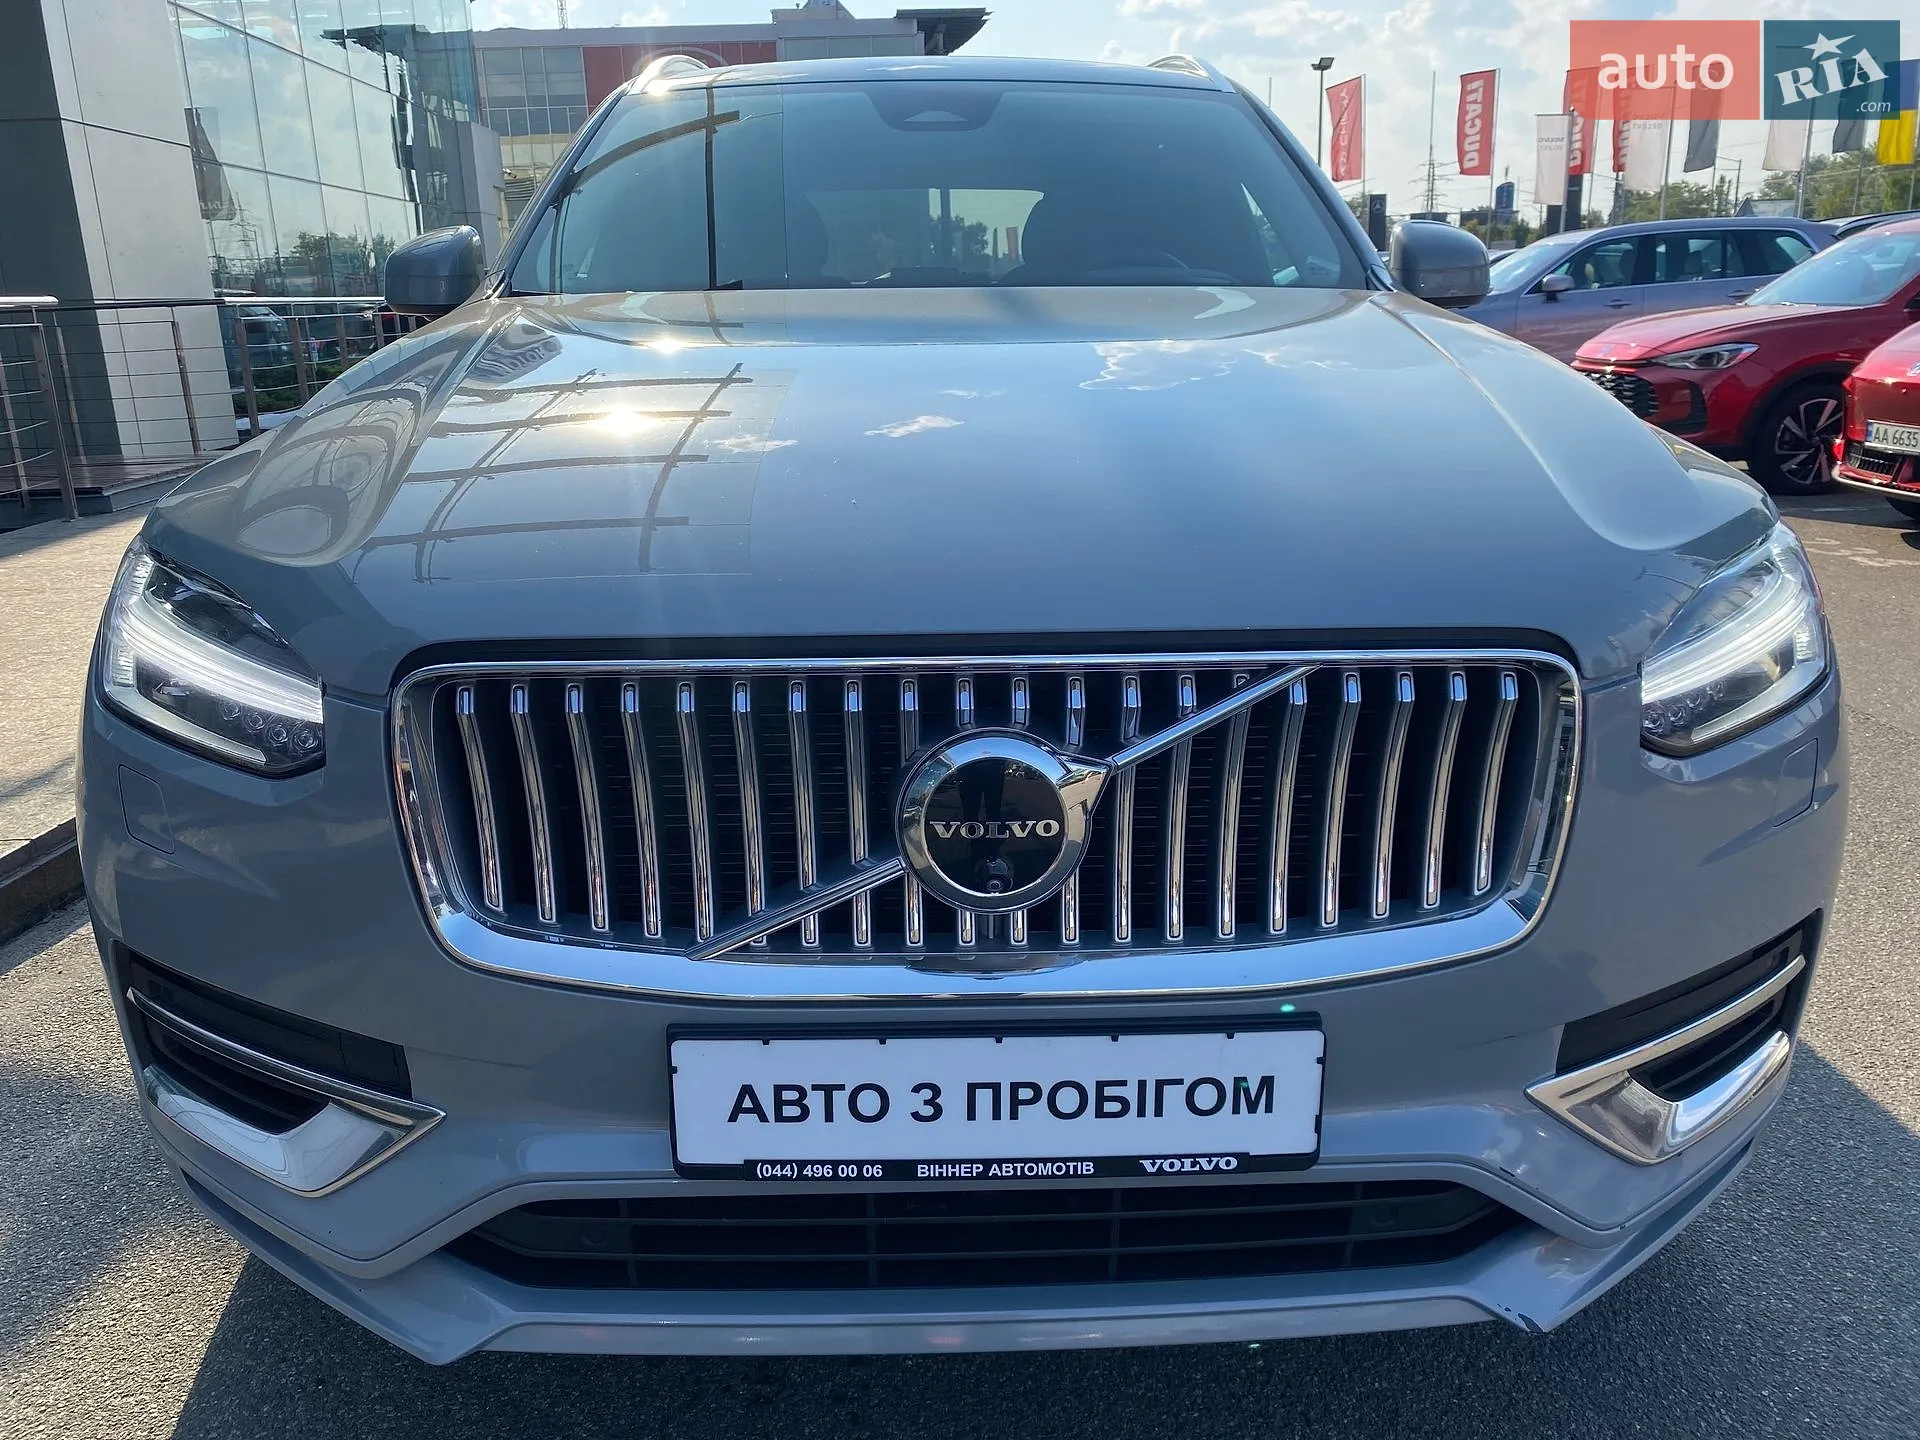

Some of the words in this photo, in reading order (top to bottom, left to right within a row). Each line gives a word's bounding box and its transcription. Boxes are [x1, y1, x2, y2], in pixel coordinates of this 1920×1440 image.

[1873, 427, 1889, 444] AA
[1892, 429, 1919, 447] 6635
[929, 819, 1060, 839] VOLVO
[727, 1082, 890, 1123] АВТО
[965, 1075, 1275, 1122] ПРОБІГОМ
[756, 1162, 797, 1178] (044)
[803, 1164, 833, 1177] 496
[838, 1164, 858, 1177] 00
[863, 1163, 883, 1177] 06
[917, 1163, 984, 1177] ВІННЕР
[988, 1161, 1094, 1177] АВТОМОТІВ
[1139, 1156, 1238, 1173] VOLVO
